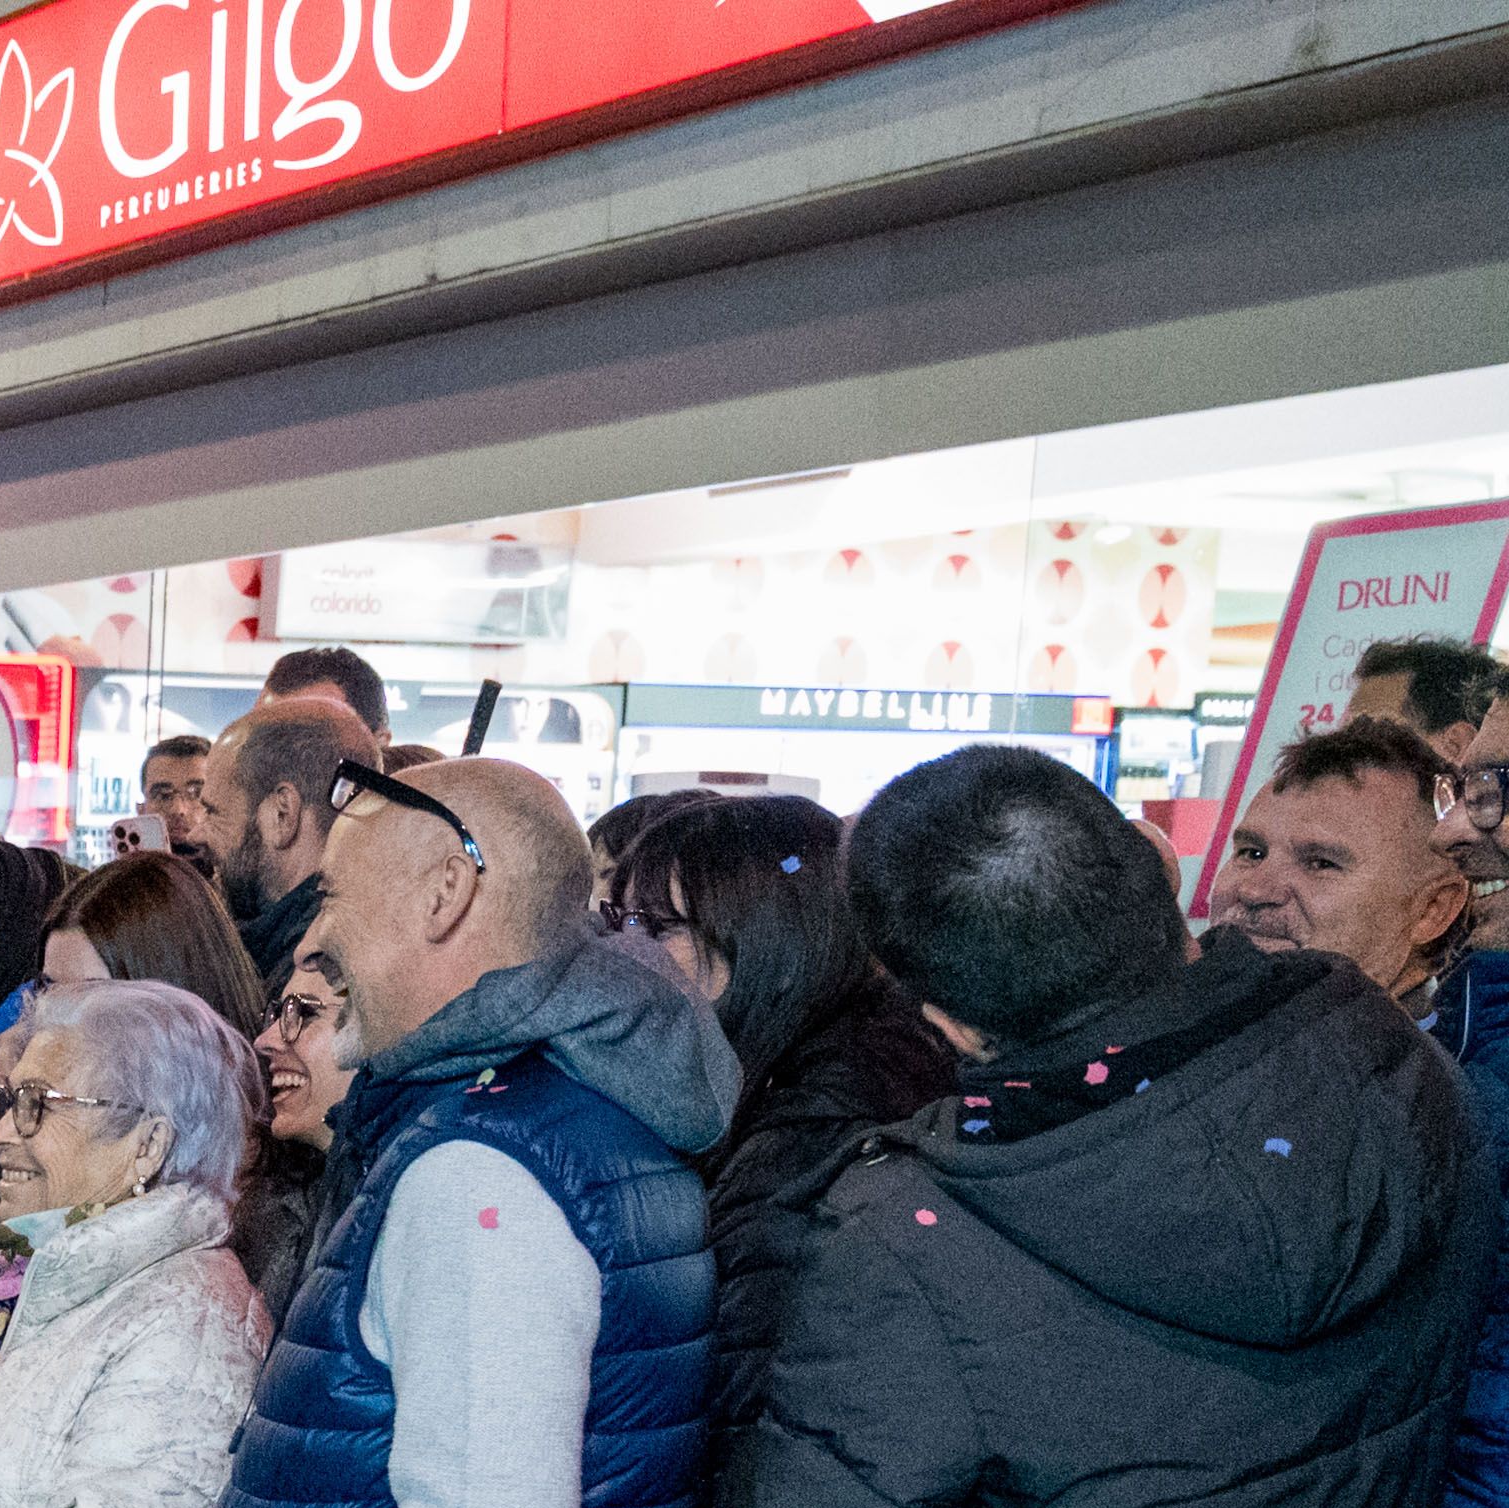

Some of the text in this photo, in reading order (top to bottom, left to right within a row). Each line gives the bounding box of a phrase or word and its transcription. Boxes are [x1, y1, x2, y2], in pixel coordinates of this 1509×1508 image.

[99, 0, 471, 178] Gilgo
[100, 158, 262, 228] PERFUMERIES
[310, 591, 382, 615] colorido
[1337, 571, 1450, 612] DRUNI
[760, 687, 992, 730] MAYBELLINE
[1299, 703, 1335, 727] 24
